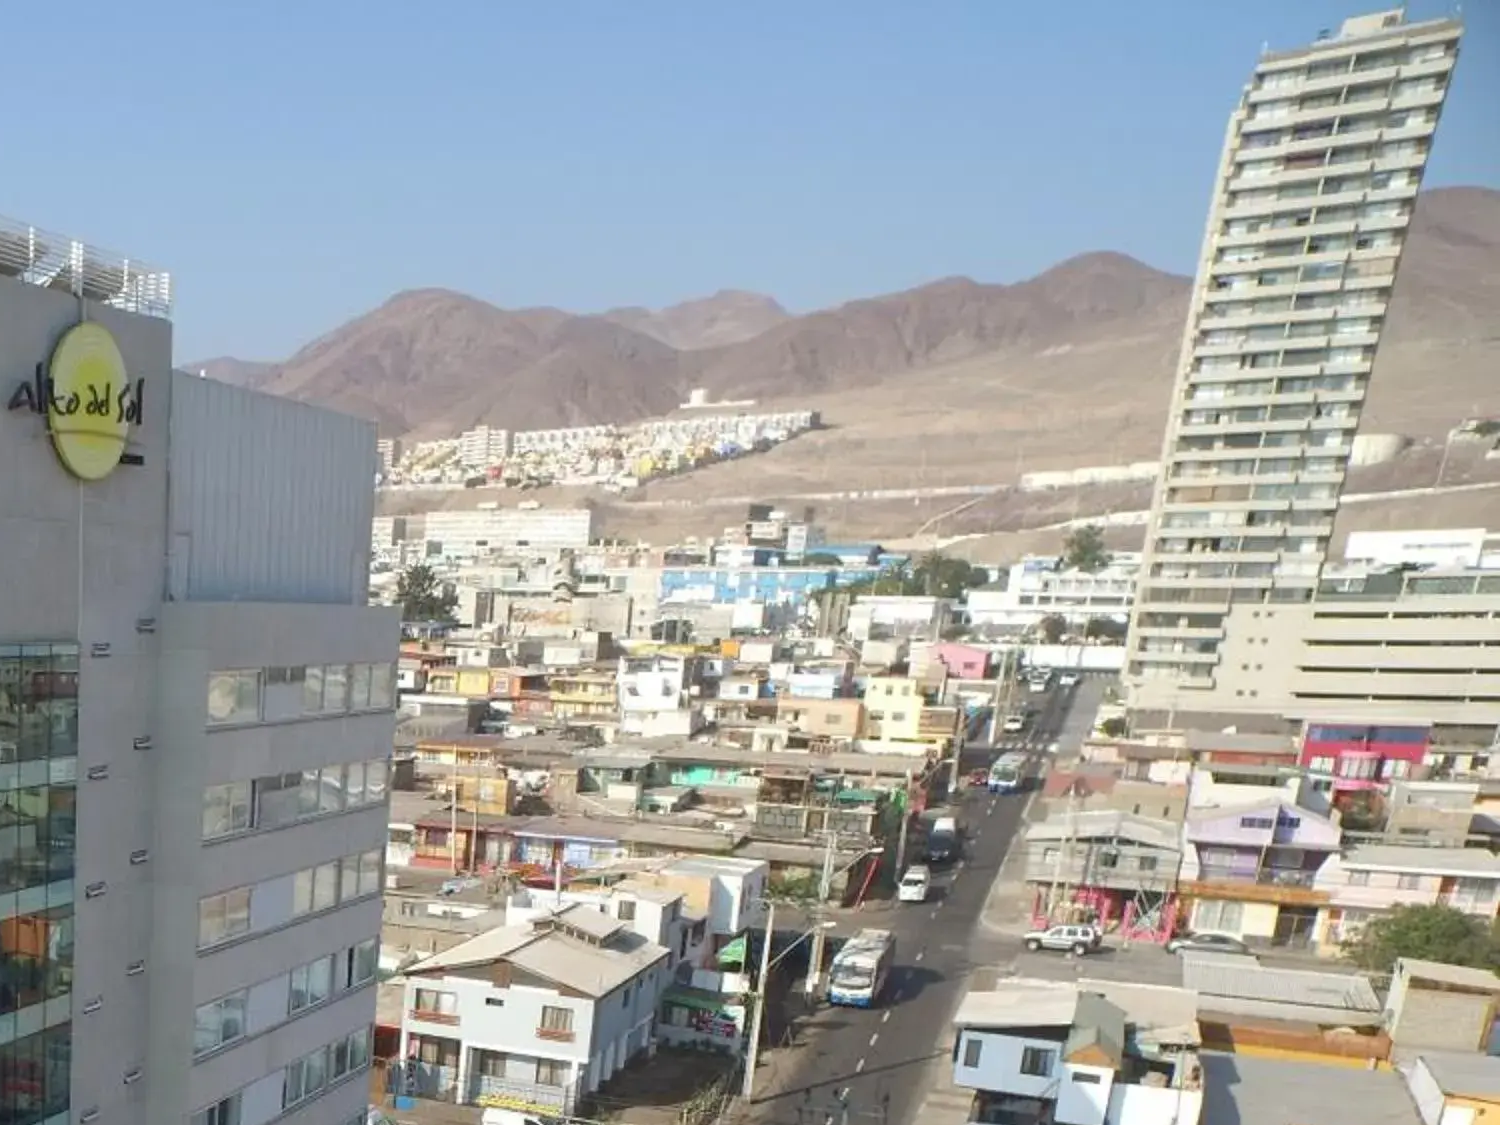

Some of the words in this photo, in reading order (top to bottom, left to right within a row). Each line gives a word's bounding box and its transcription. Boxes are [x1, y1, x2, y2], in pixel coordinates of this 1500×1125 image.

[8, 362, 81, 417] Alto
[86, 383, 111, 417] del
[116, 378, 145, 426] Sol
